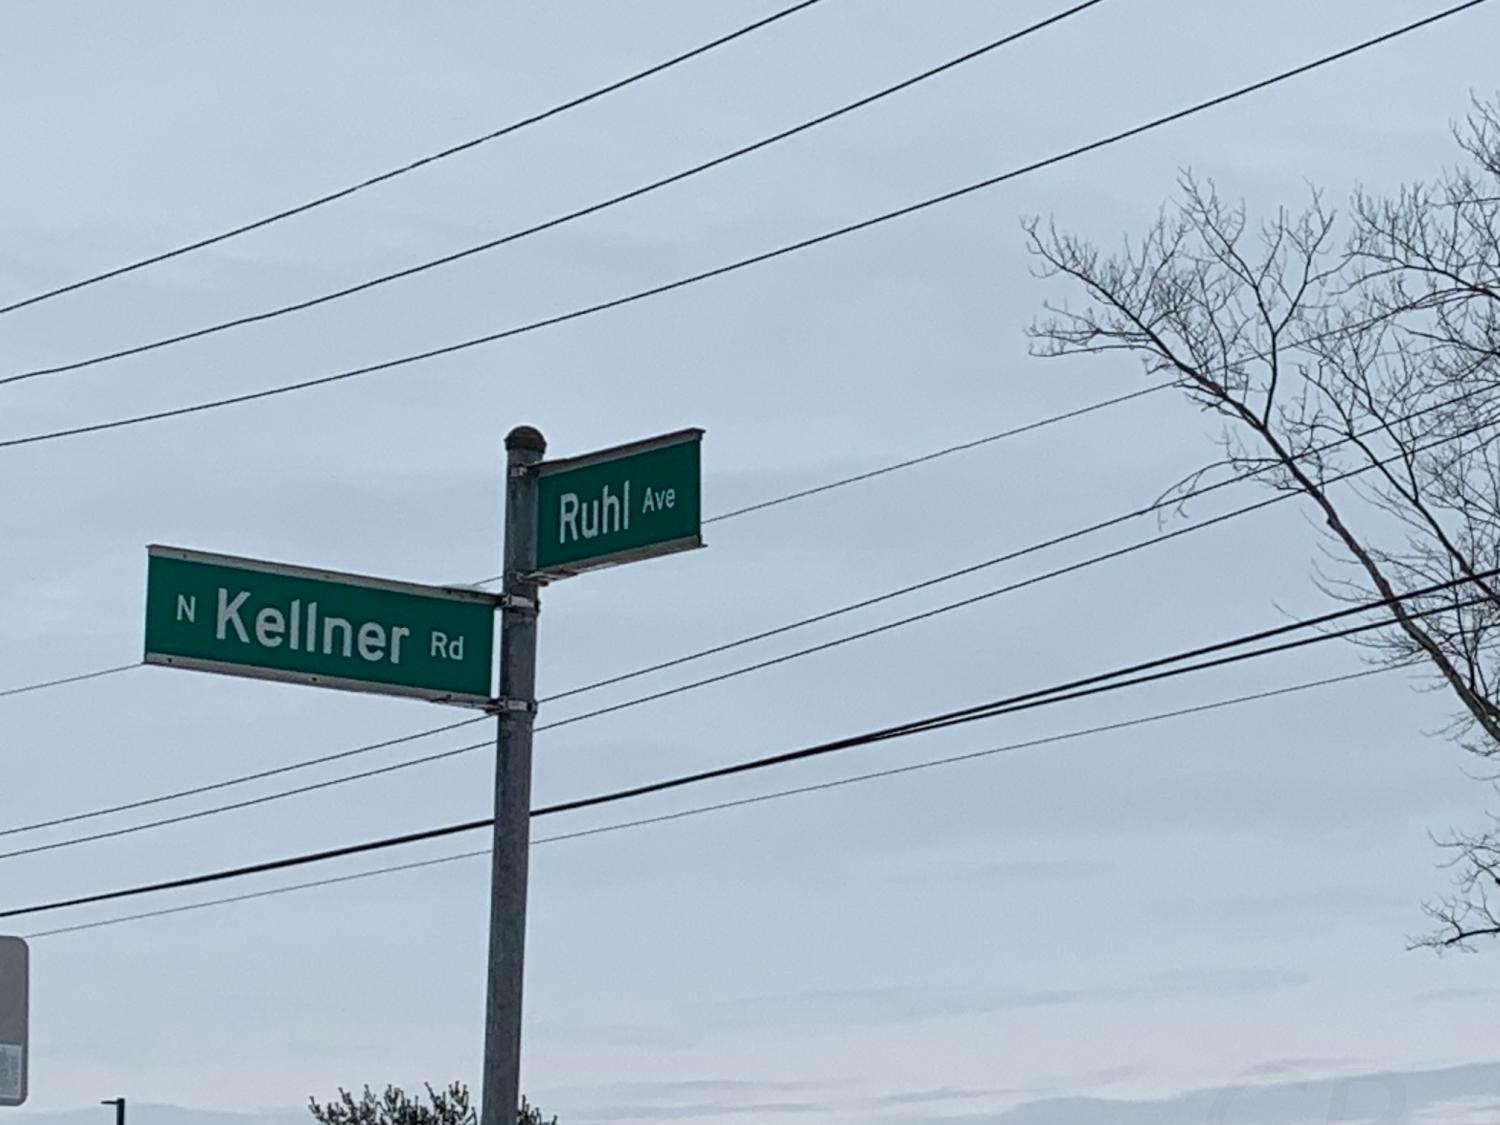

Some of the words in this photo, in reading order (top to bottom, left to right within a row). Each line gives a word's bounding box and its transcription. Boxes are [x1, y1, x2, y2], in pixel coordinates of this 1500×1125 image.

[559, 479, 631, 545] Ruhl
[642, 486, 677, 515] Ave
[176, 594, 196, 623] N
[215, 586, 411, 665] Kellner
[430, 630, 465, 661] Rd
